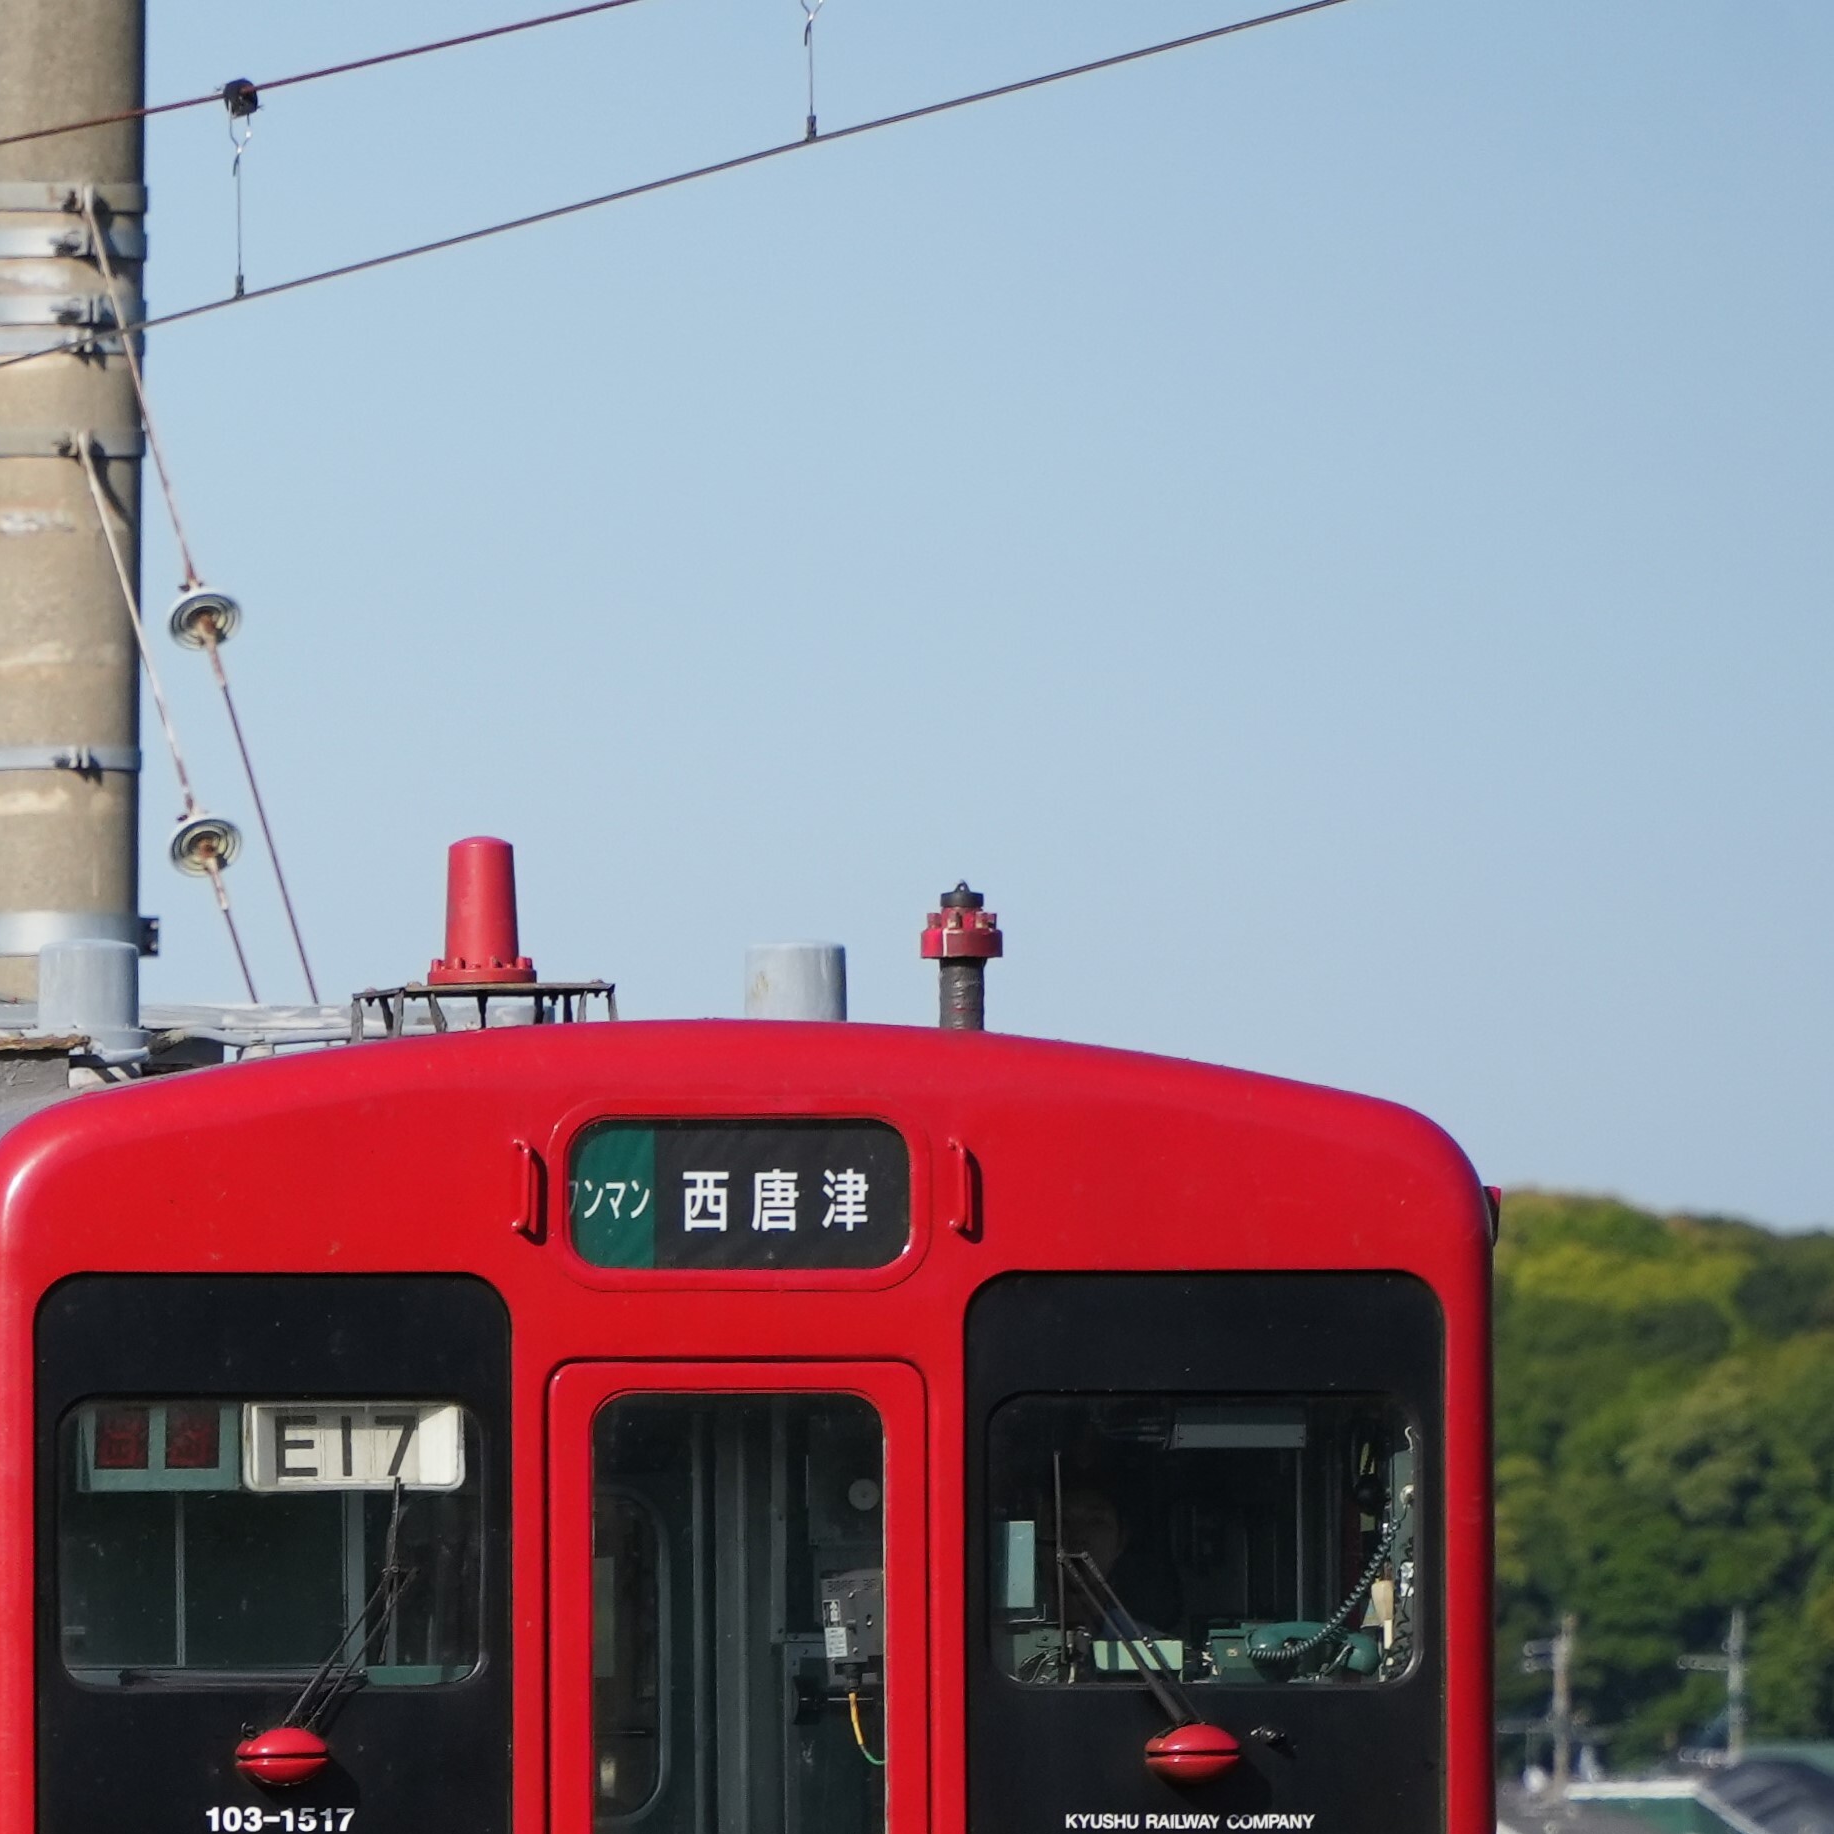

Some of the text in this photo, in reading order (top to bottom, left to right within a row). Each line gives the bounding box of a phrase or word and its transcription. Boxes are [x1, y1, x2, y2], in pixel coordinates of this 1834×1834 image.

[682, 1168, 870, 1232] 西唐津
[275, 1415, 417, 1477] E17
[205, 1806, 356, 1833] 103-1517
[1065, 1813, 1316, 1830] KYUSHU RAILWAY COMPANY
